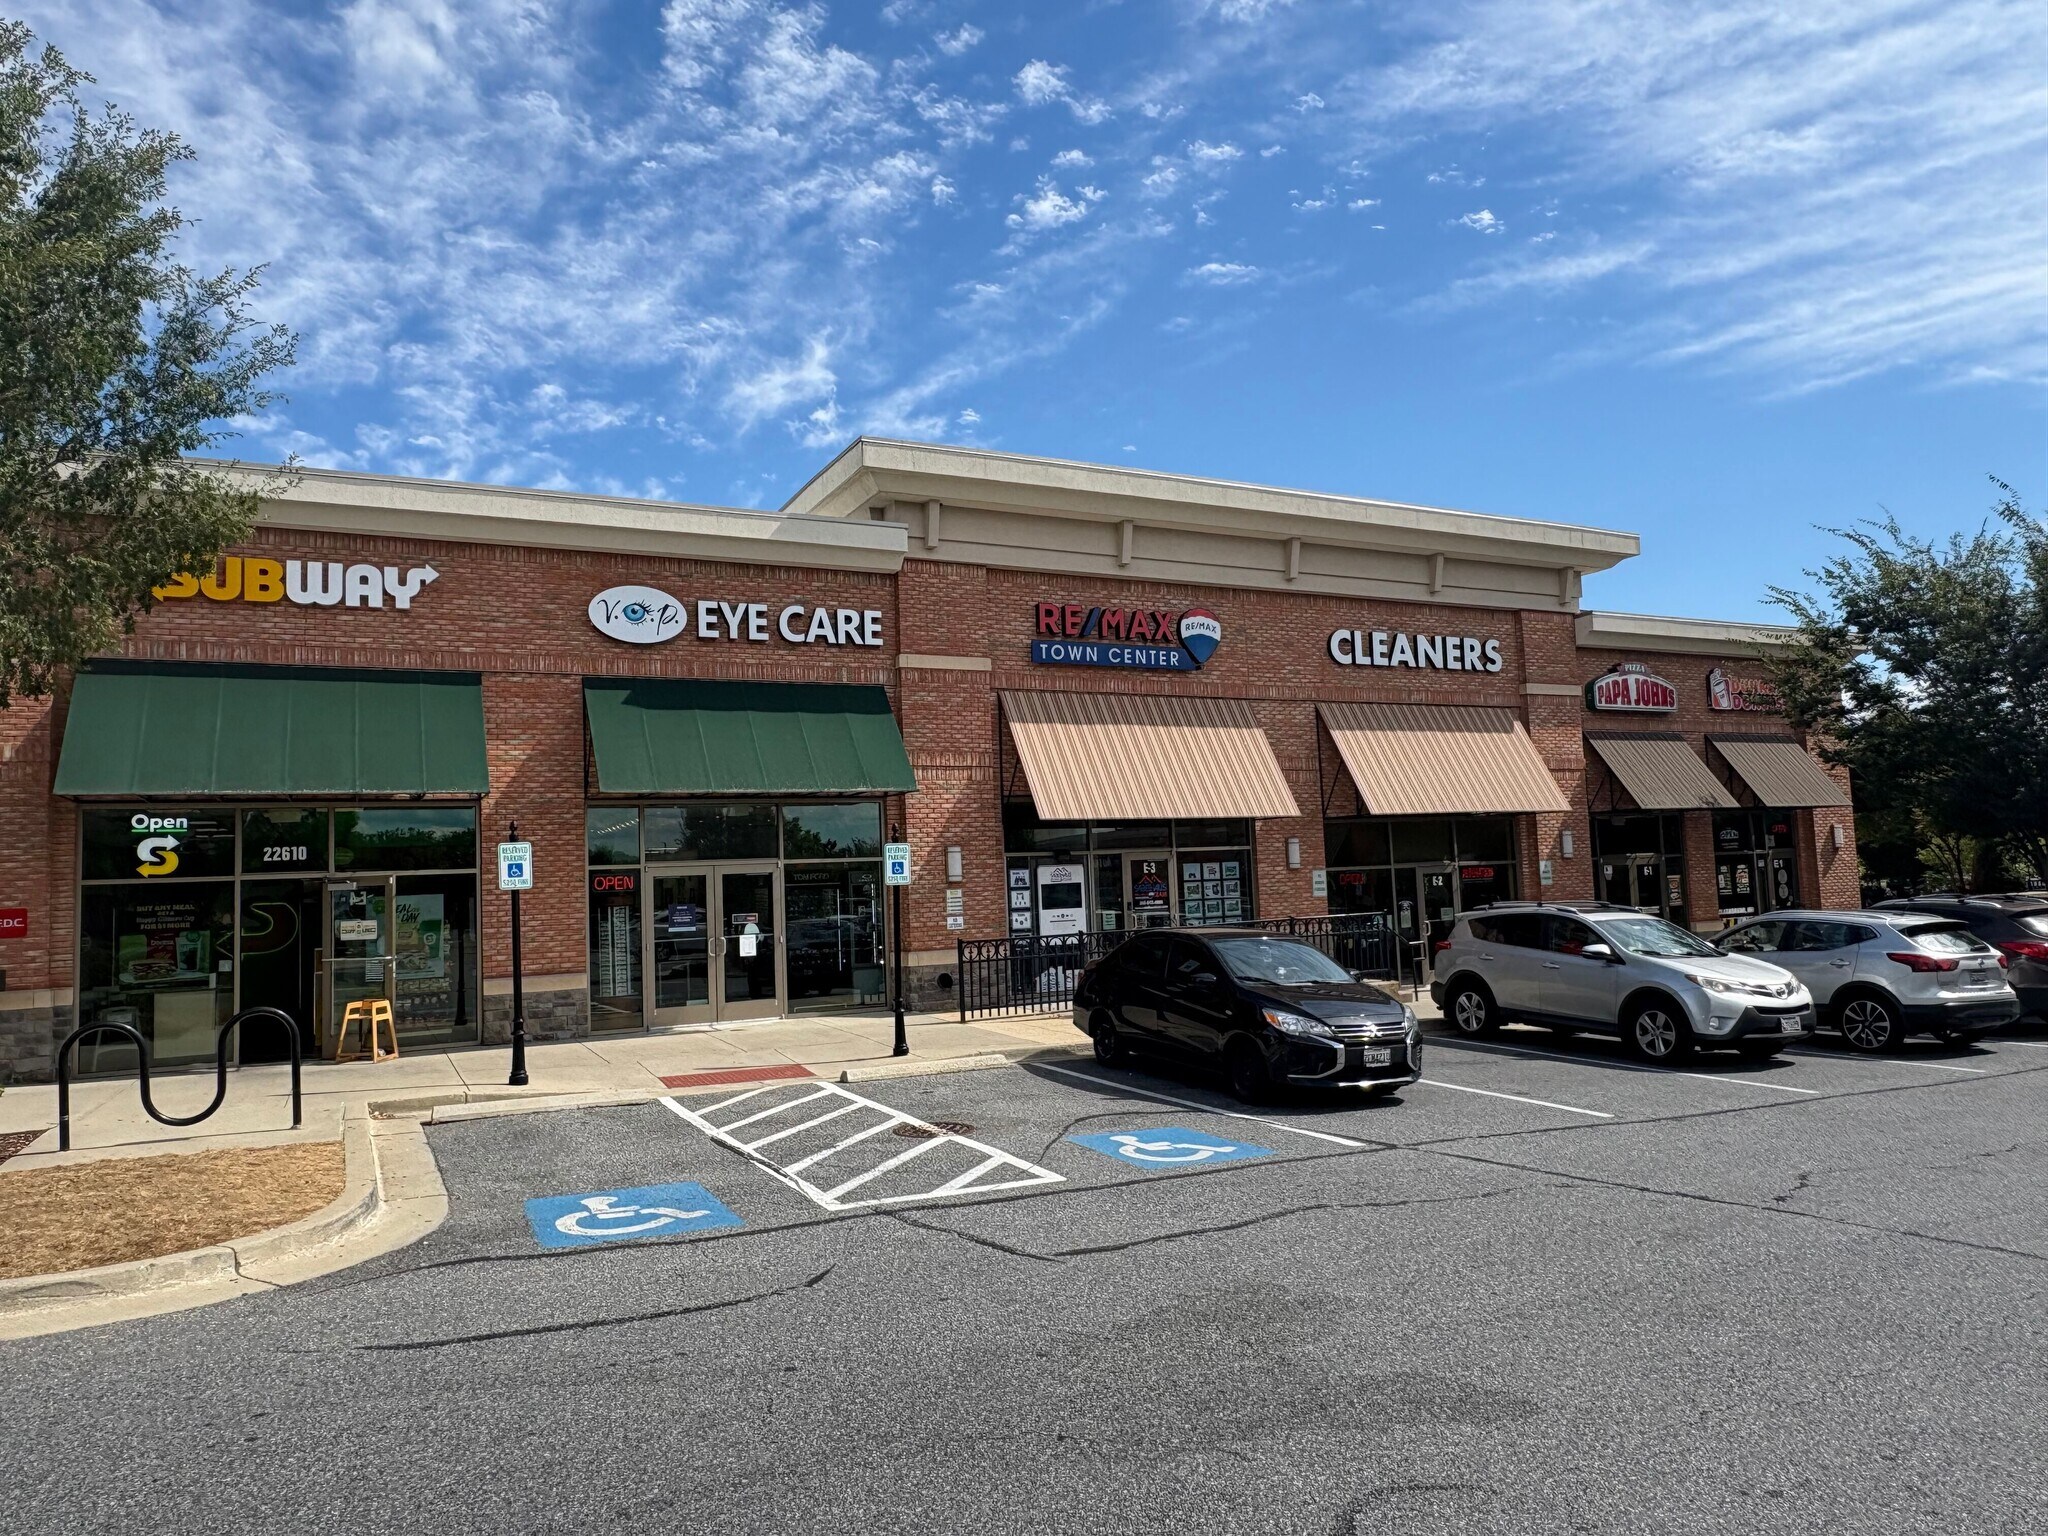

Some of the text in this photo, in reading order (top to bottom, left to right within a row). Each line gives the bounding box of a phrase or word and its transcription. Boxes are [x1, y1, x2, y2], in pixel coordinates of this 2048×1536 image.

[152, 556, 440, 609] SUBWAY
[697, 600, 883, 646] EYE CARE
[1036, 602, 1175, 642] RE/MAX
[1185, 621, 1217, 634] RE/MAX
[1040, 644, 1179, 666] TOWN CENTER
[1328, 629, 1503, 672] CLEANERS
[1597, 678, 1632, 705] PAPA
[131, 814, 188, 832] Open
[263, 846, 307, 862] 22610
[594, 876, 634, 890] OPEN
